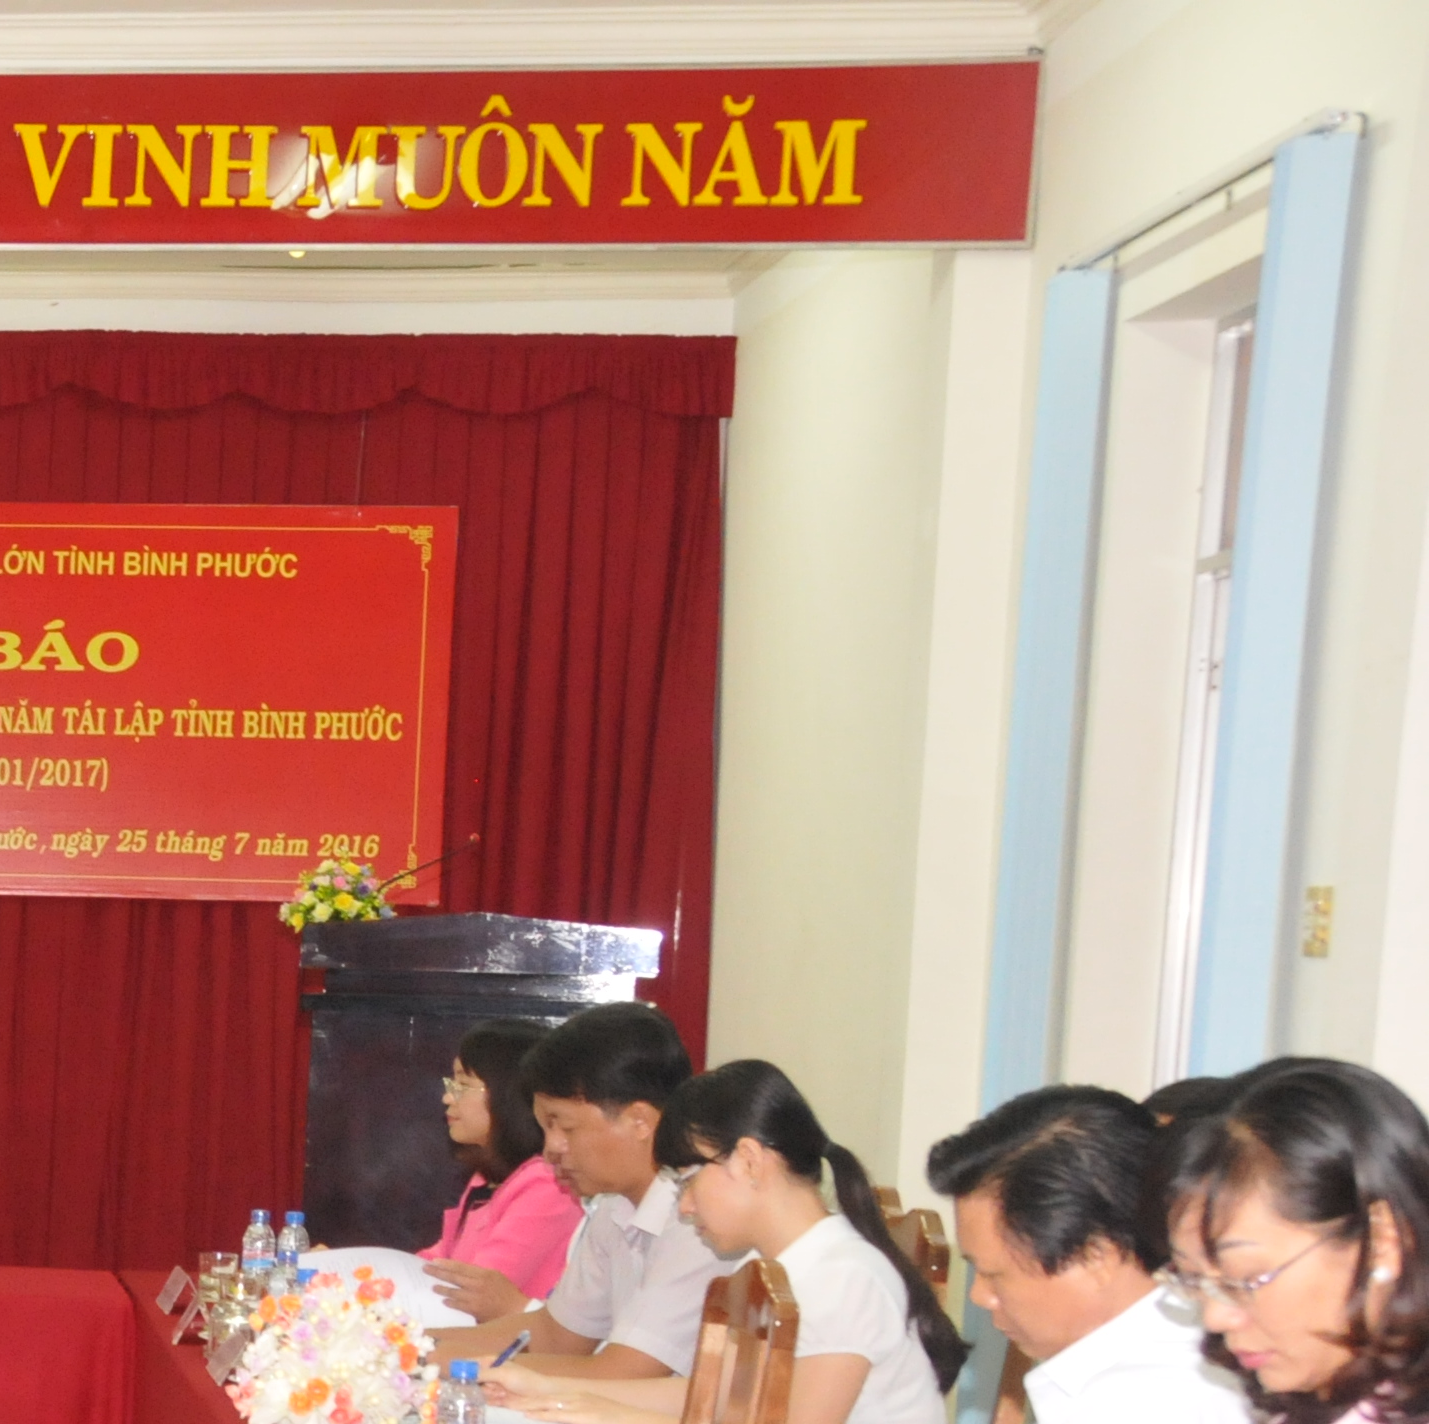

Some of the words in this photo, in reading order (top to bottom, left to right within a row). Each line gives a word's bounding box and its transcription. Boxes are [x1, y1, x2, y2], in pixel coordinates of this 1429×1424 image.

[14, 123, 278, 208] VINH
[295, 95, 604, 210] MUÔN
[622, 96, 868, 207] NĂM
[124, 546, 187, 576] BÌNH
[197, 547, 297, 578] PHƯỚC
[62, 700, 106, 735] TÁI
[114, 701, 164, 742] LẬP
[171, 699, 234, 737] TỈNH
[242, 703, 306, 739] BÌNH
[314, 705, 402, 741] PHƯỚC
[50, 828, 109, 858] ngày
[116, 830, 147, 852] 25
[156, 830, 226, 861] tháng
[235, 832, 250, 854] 7
[255, 833, 308, 856] năm
[317, 834, 380, 858] 2016
